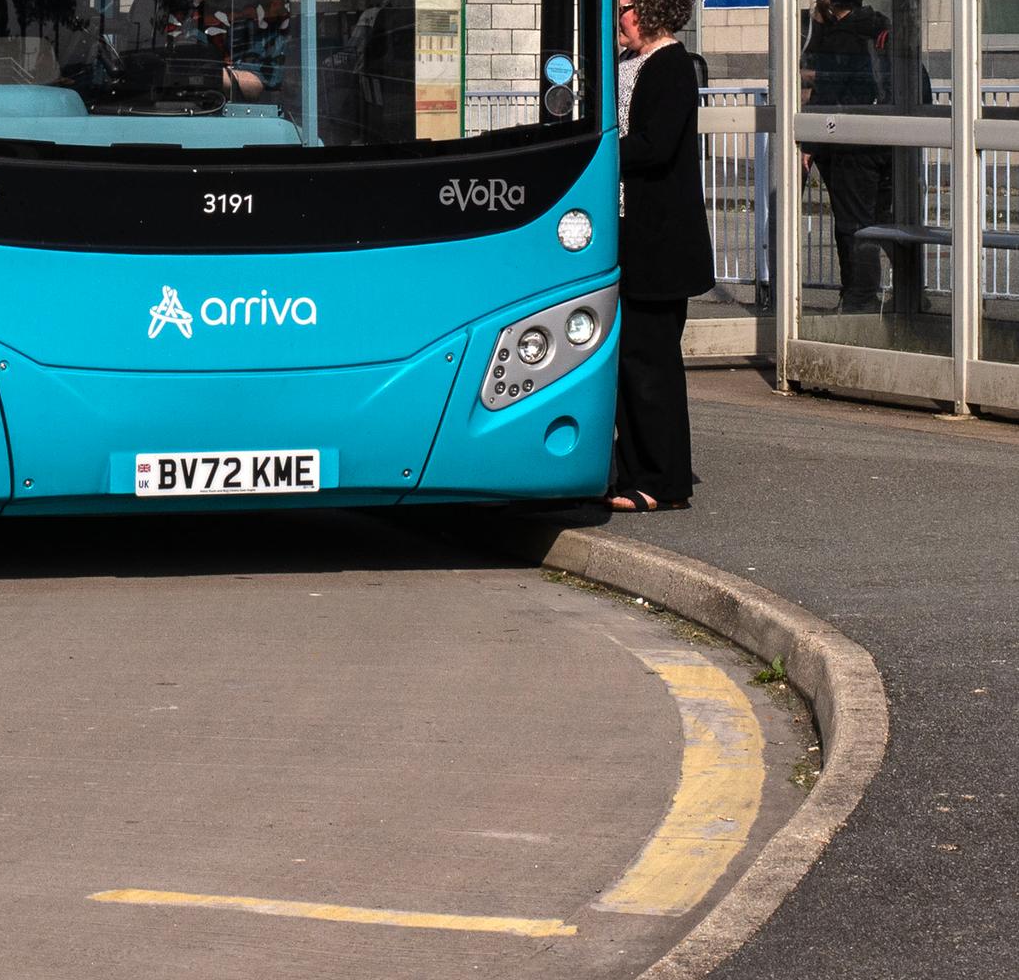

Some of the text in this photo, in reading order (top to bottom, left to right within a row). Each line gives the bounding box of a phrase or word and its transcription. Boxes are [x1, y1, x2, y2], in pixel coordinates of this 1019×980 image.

[202, 193, 254, 215] 3191
[200, 288, 318, 327] arriva
[138, 479, 150, 489] UK
[158, 455, 314, 490] BV72 KME
